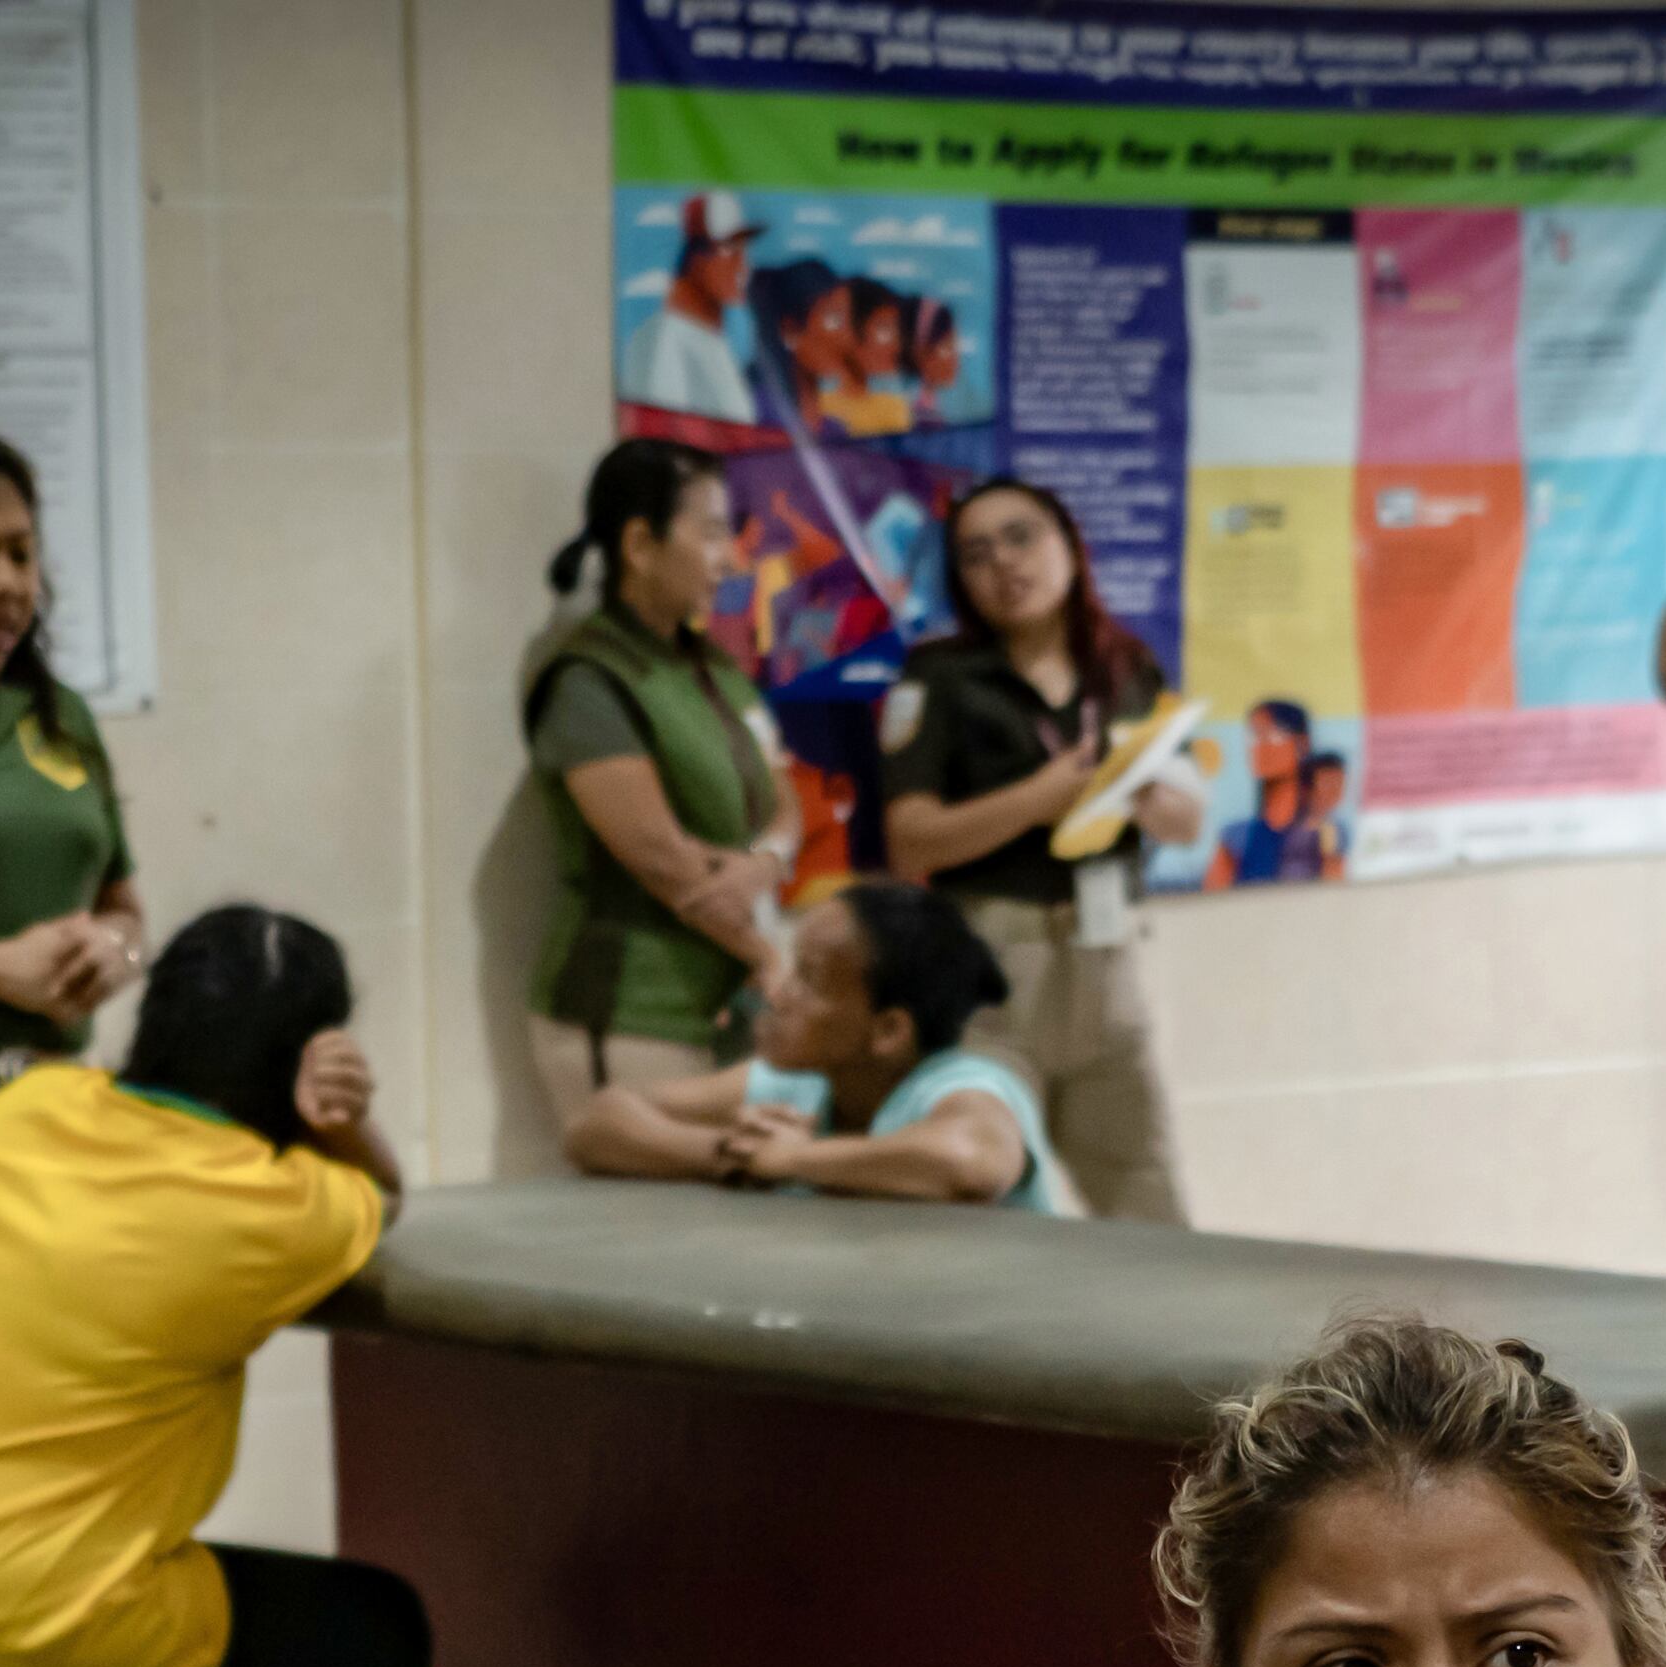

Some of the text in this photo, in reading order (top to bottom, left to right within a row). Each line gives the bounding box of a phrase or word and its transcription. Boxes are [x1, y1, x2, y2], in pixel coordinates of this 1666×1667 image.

[681, 0, 742, 30] you
[748, 4, 798, 27] are
[804, 2, 891, 34] afraid
[894, 8, 933, 37] of
[836, 130, 921, 165] How
[936, 134, 975, 167] to
[992, 131, 1104, 181] Apply
[1116, 133, 1172, 168] for
[1186, 139, 1332, 182] Refugee
[1349, 141, 1455, 176] Status
[1468, 142, 1499, 175] in
